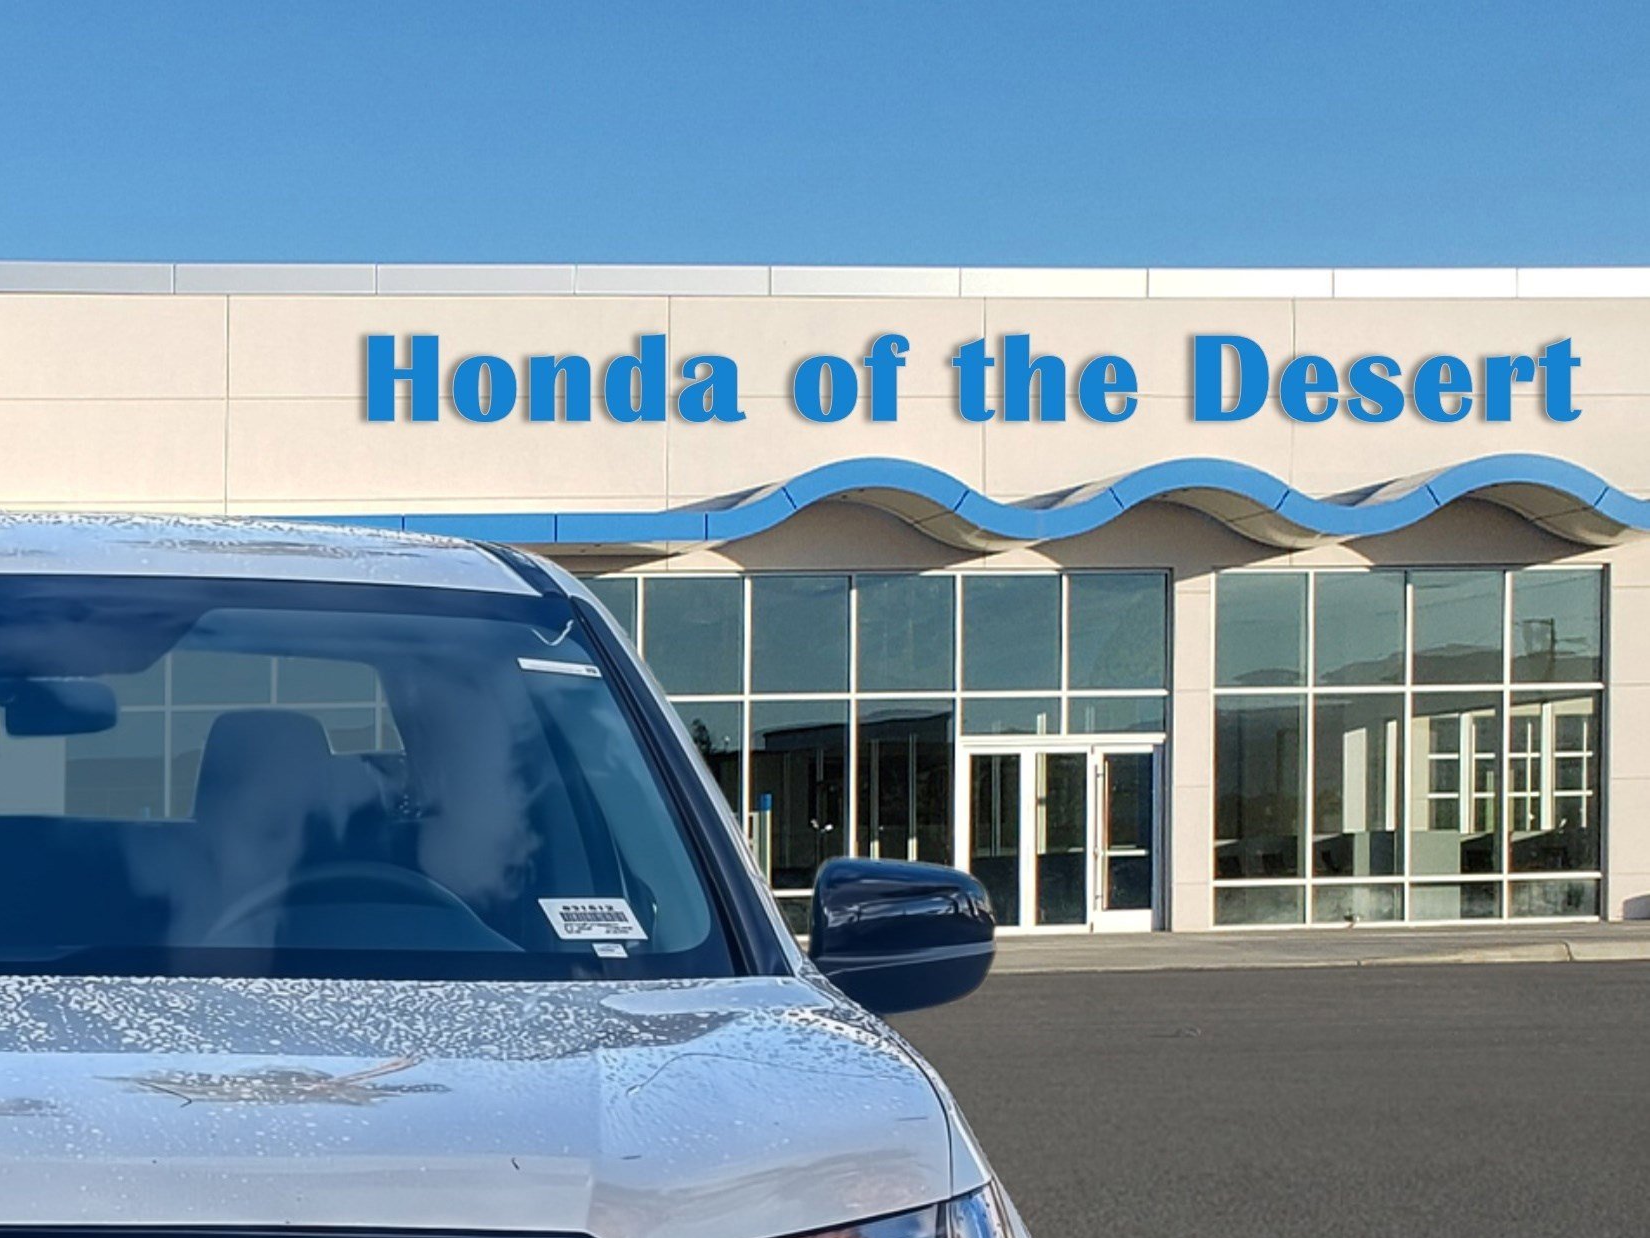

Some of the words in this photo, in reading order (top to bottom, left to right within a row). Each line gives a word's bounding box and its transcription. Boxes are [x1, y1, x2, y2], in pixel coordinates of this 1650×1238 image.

[364, 332, 748, 424] Honda
[792, 333, 912, 424] of
[950, 333, 1138, 424] the
[1192, 334, 1583, 424] Desert
